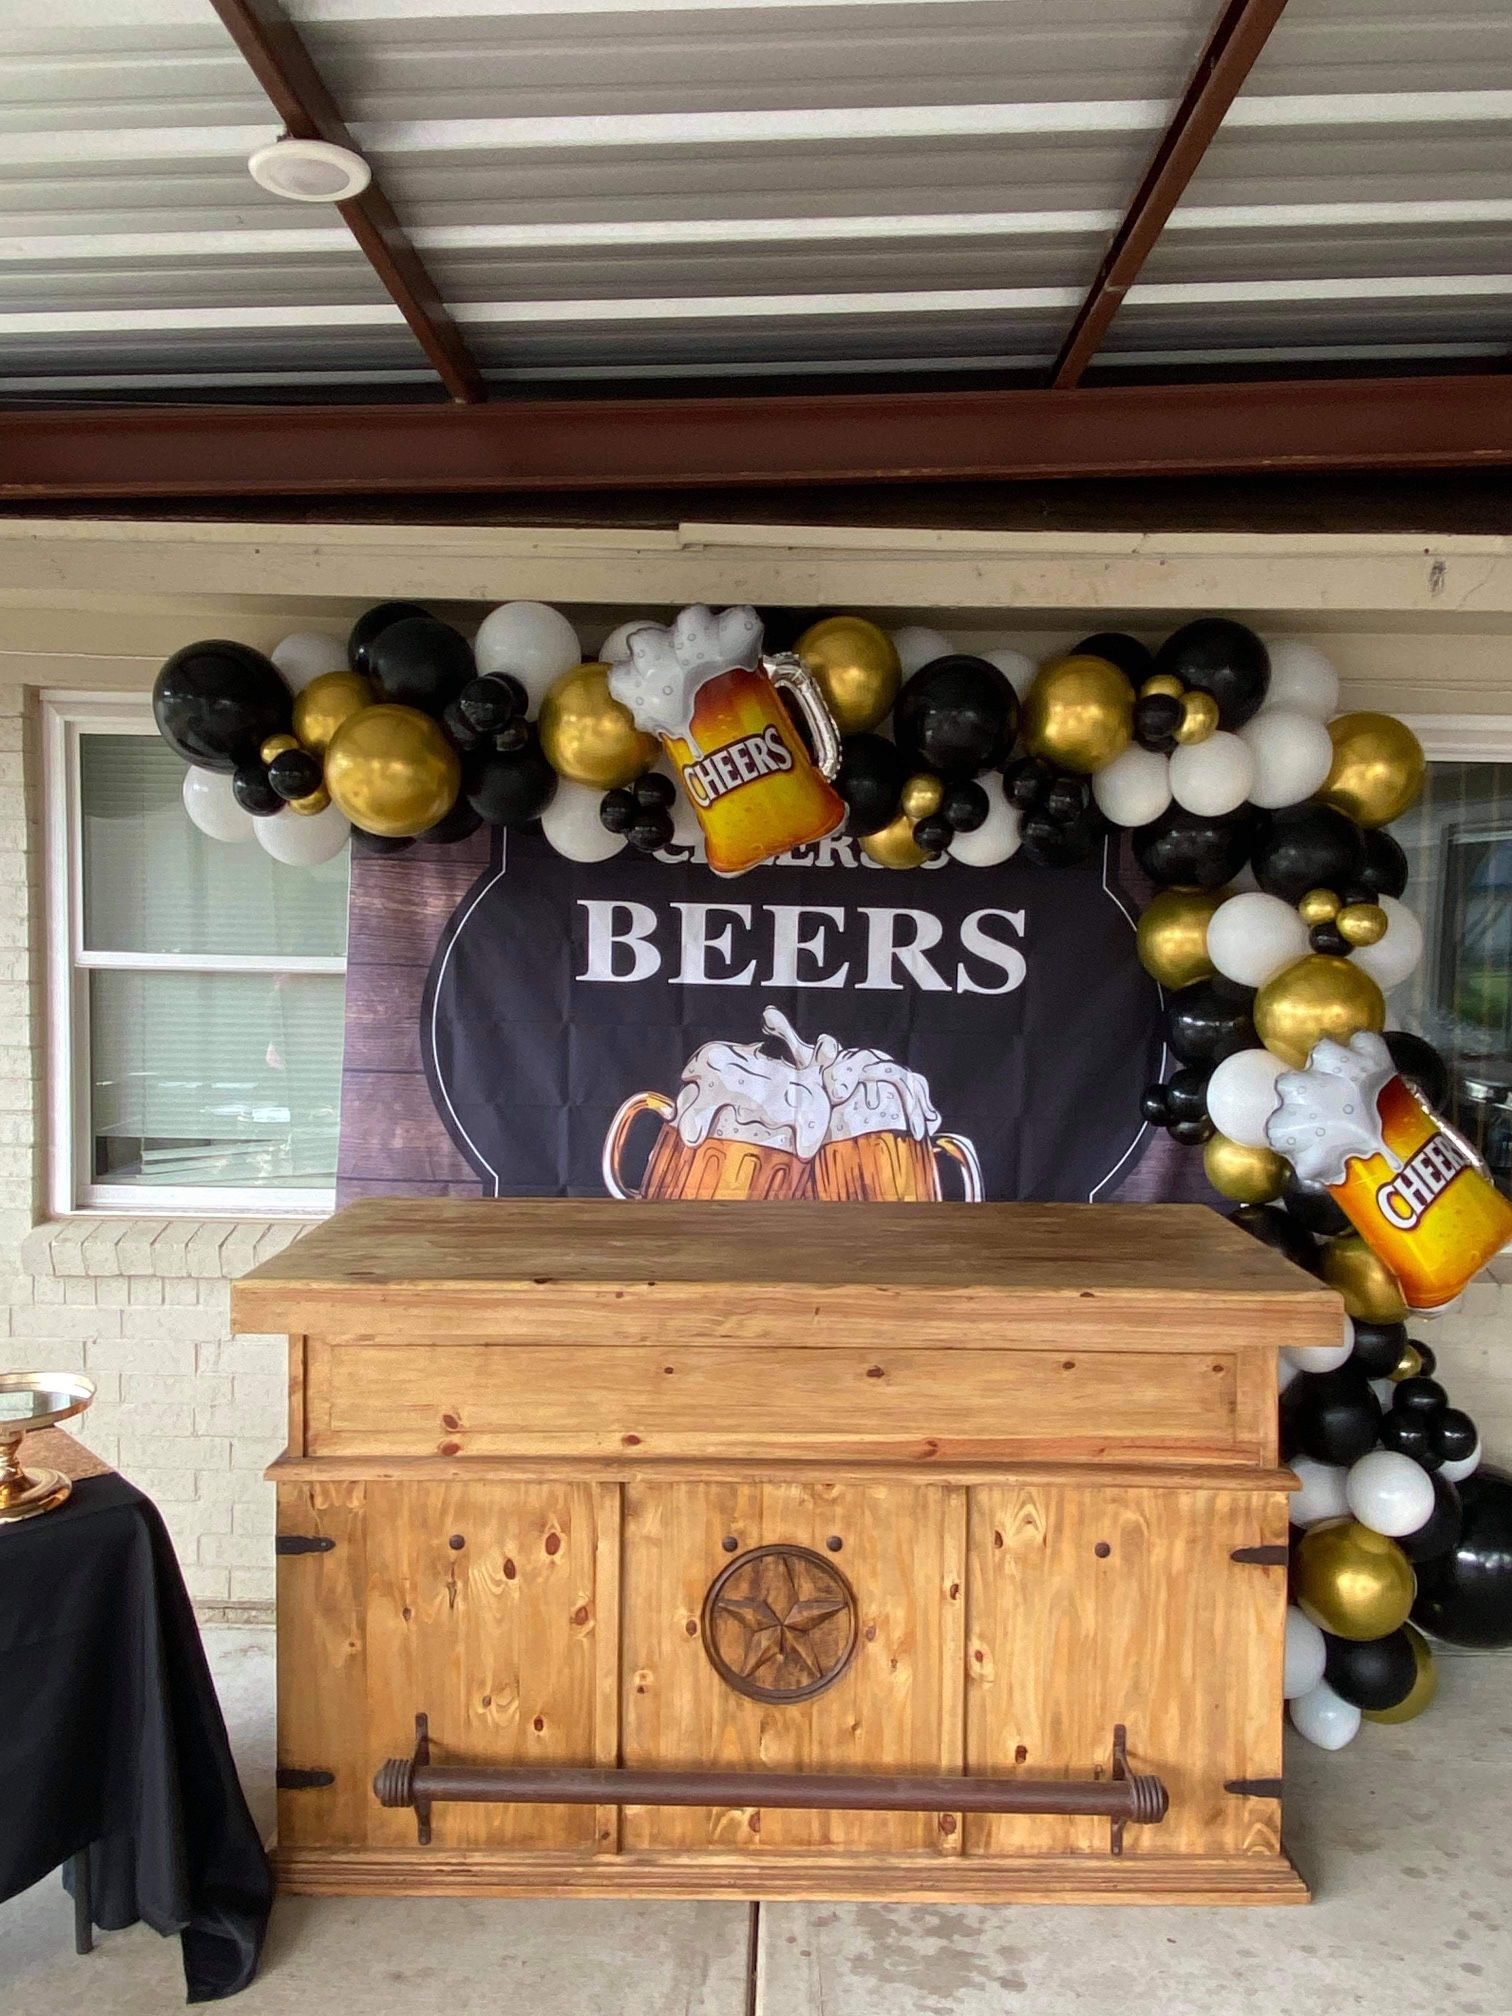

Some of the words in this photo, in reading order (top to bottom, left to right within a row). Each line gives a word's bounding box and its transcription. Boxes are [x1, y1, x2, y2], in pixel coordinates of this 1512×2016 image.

[683, 725, 793, 807] CHEERS
[575, 899, 1027, 994] BEERS
[1377, 1130, 1470, 1230] CHEER
